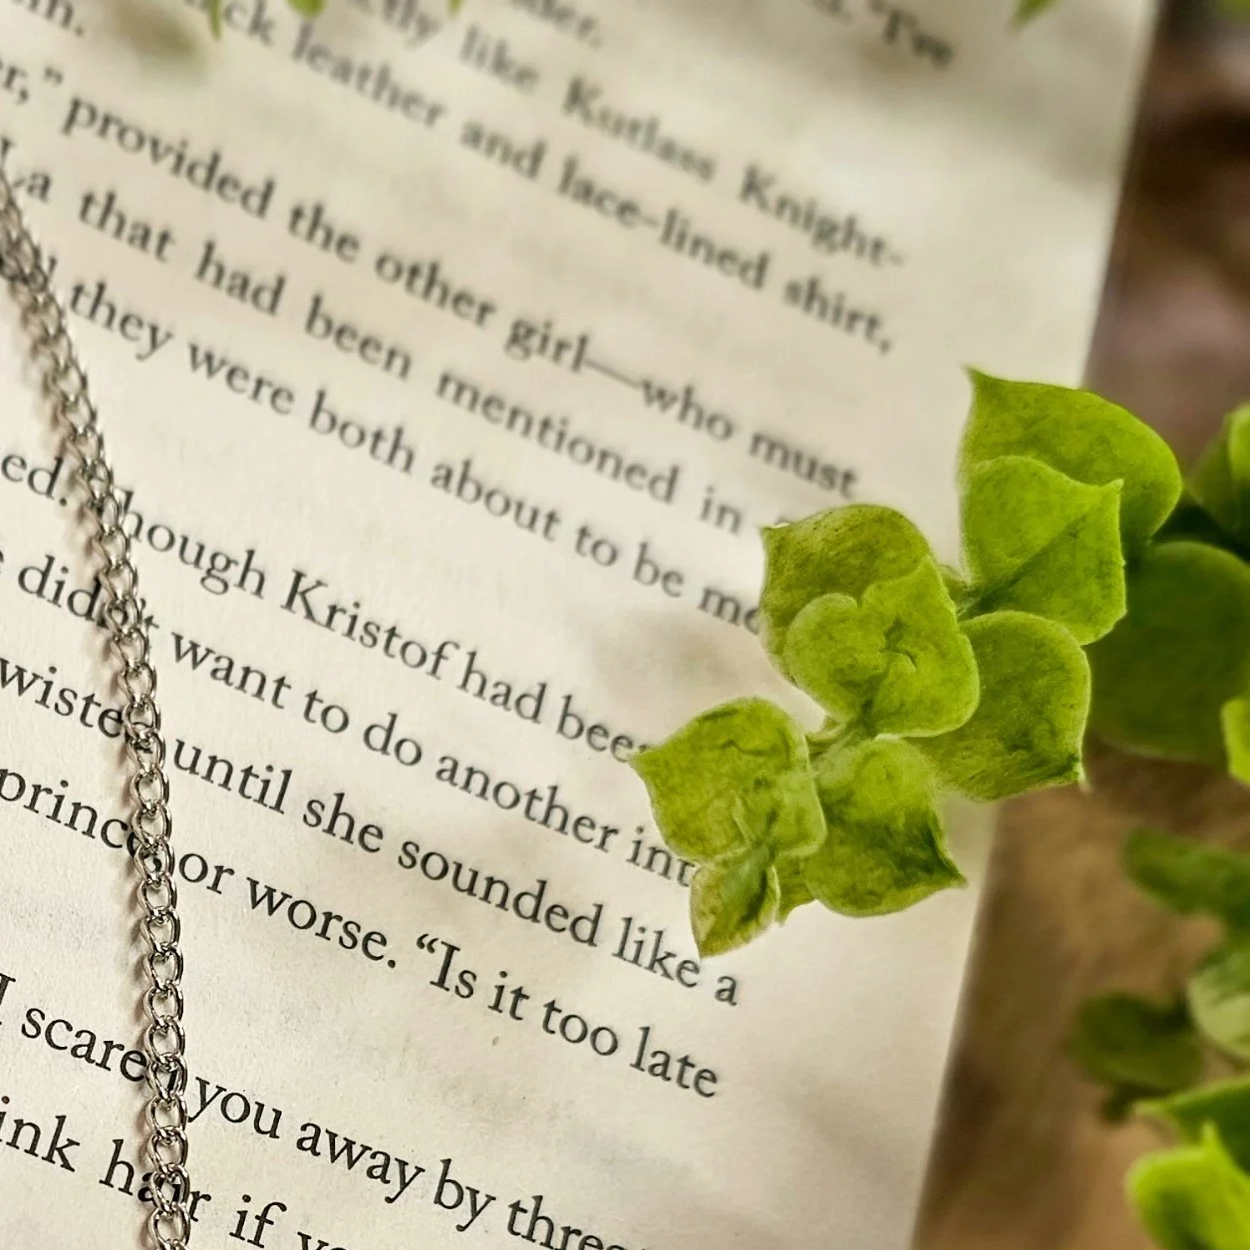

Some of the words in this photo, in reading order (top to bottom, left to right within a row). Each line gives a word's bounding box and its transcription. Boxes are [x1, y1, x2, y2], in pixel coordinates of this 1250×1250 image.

[291, 23, 446, 128] leather
[462, 123, 547, 180] and
[62, 96, 276, 219] provided
[288, 202, 360, 263] the
[374, 252, 497, 327] other
[749, 432, 857, 497] must
[79, 190, 175, 262] that
[194, 239, 287, 316] had
[305, 292, 411, 379] been
[436, 372, 680, 504] mentioned
[701, 487, 741, 533] in
[72, 280, 174, 361] they
[189, 343, 294, 415] were
[309, 388, 415, 474] both
[430, 458, 561, 541] about
[575, 524, 620, 566] to
[633, 541, 684, 597] be
[18, 555, 160, 640] did’t
[171, 632, 292, 709] want
[303, 690, 349, 734] to
[363, 712, 422, 766] do
[436, 756, 619, 852] another
[280, 569, 460, 680] Kristof
[457, 650, 547, 724] had
[556, 694, 649, 764] bee
[174, 739, 292, 815] until
[303, 792, 383, 853] she
[398, 841, 604, 947] sounded
[612, 917, 707, 988] like
[715, 976, 738, 1006] a
[181, 853, 235, 895] or
[246, 877, 396, 968] worse.
[414, 934, 479, 1000] “Is
[487, 971, 530, 1021] it
[542, 1000, 619, 1056] too
[630, 1026, 718, 1098] late
[21, 1008, 177, 1092] scare
[187, 1077, 284, 1141] you
[296, 1122, 426, 1204] away
[433, 1158, 496, 1232] by
[229, 1194, 287, 1249] if
